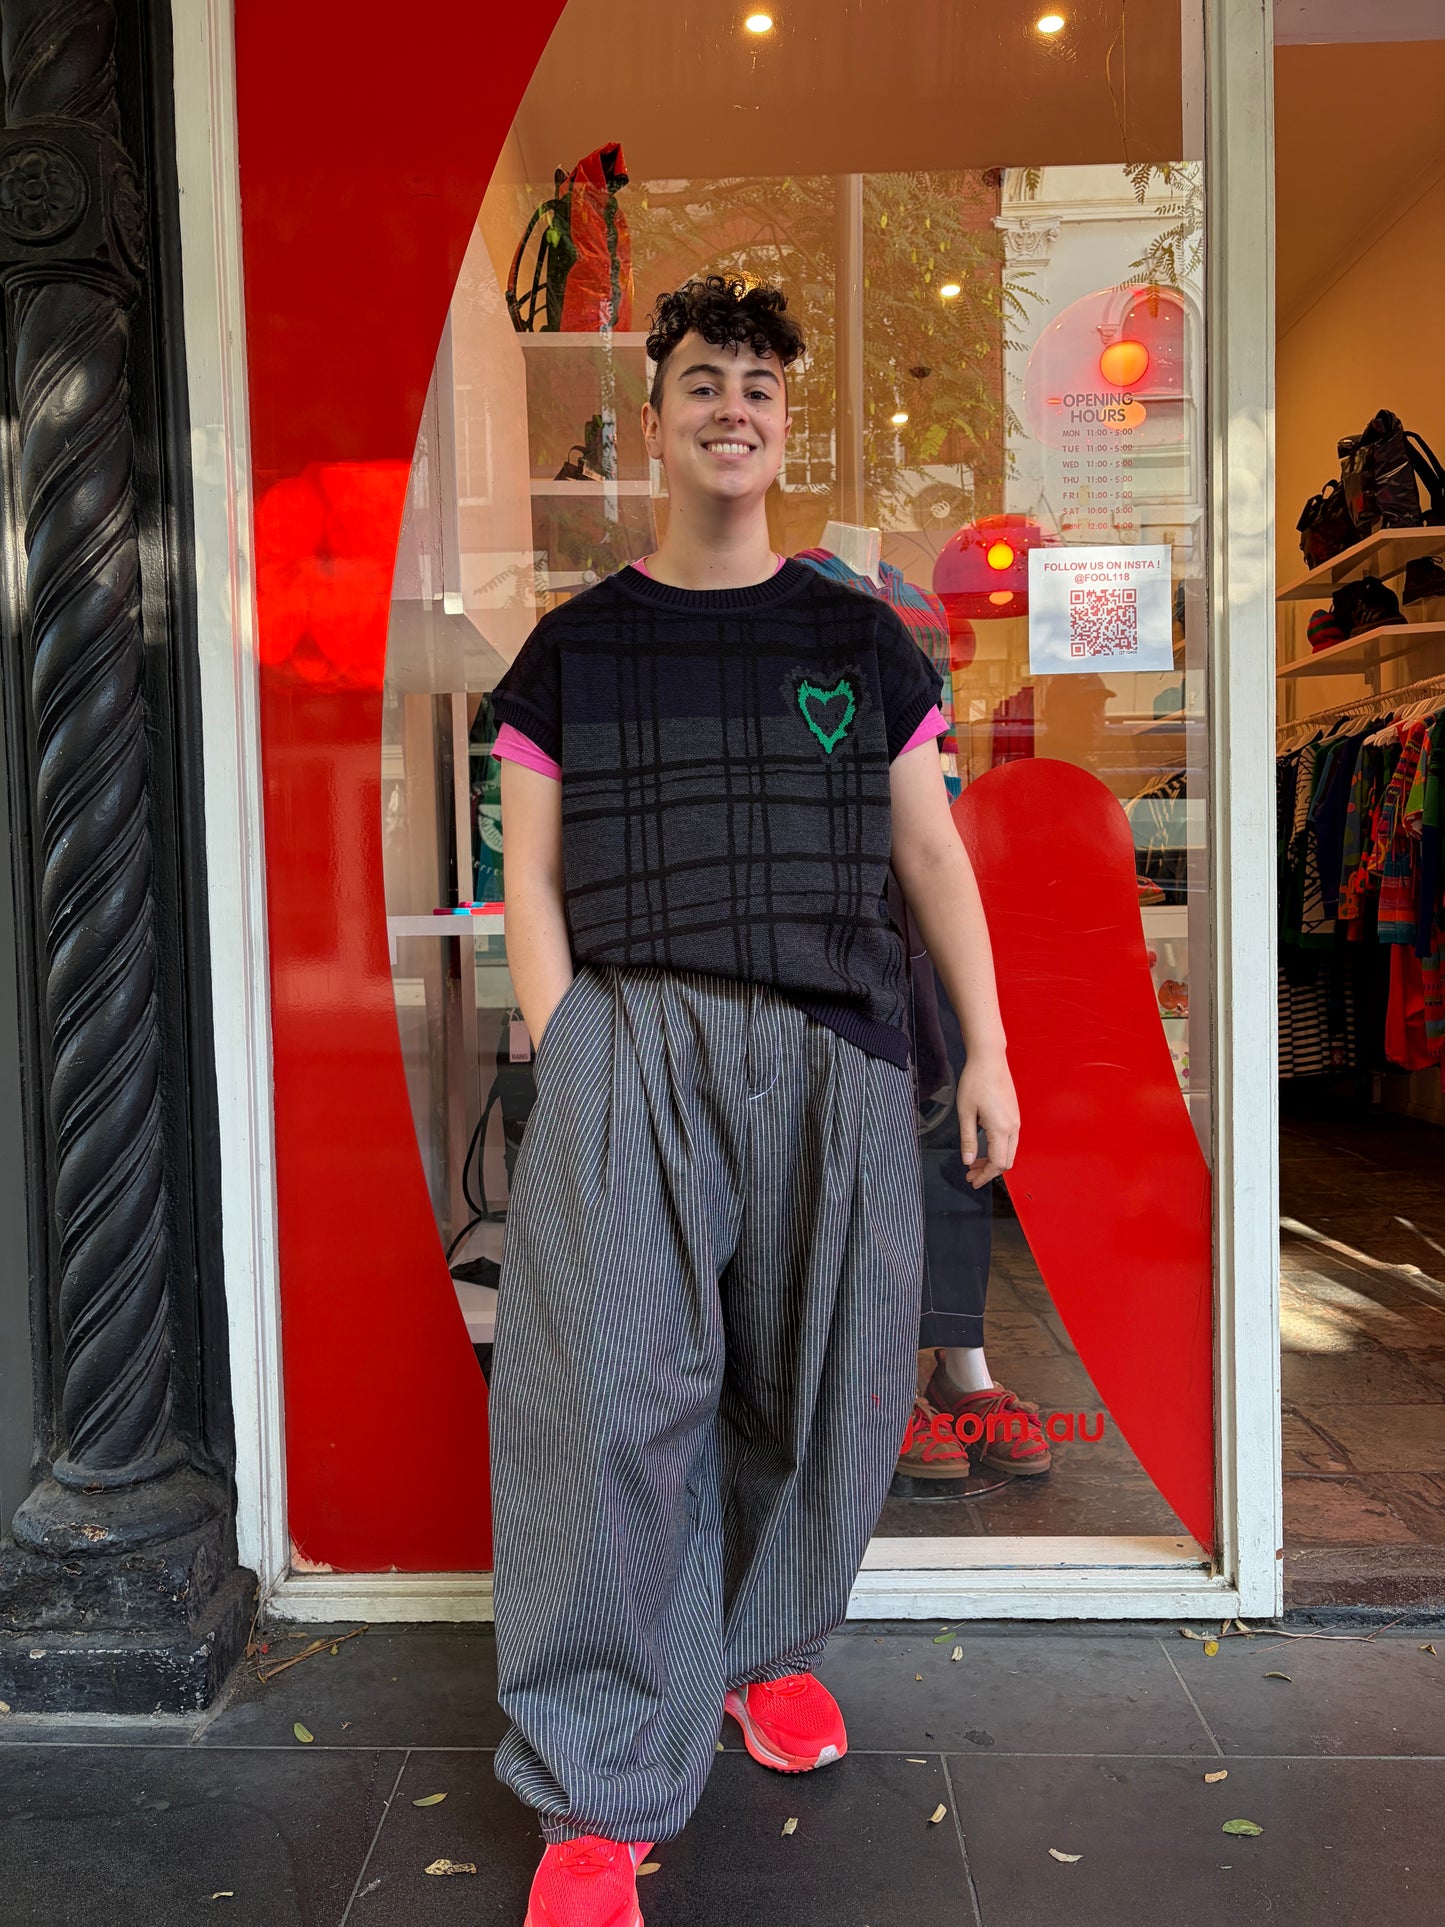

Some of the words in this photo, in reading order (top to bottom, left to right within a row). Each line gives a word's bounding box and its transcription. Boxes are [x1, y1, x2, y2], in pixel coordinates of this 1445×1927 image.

[1063, 393, 1134, 407] OPENING
[1071, 409, 1126, 423] HOURS
[1115, 428, 1132, 436] 5:00
[1115, 444, 1132, 452] 5:00
[1115, 475, 1132, 483] 5:00
[1115, 506, 1132, 514] 5:00
[1044, 562, 1087, 571] FOLLOW
[1090, 561, 1104, 570] US
[1106, 561, 1121, 570] ON
[1124, 560, 1154, 569] INSTA
[1075, 573, 1130, 584] @FOOL118
